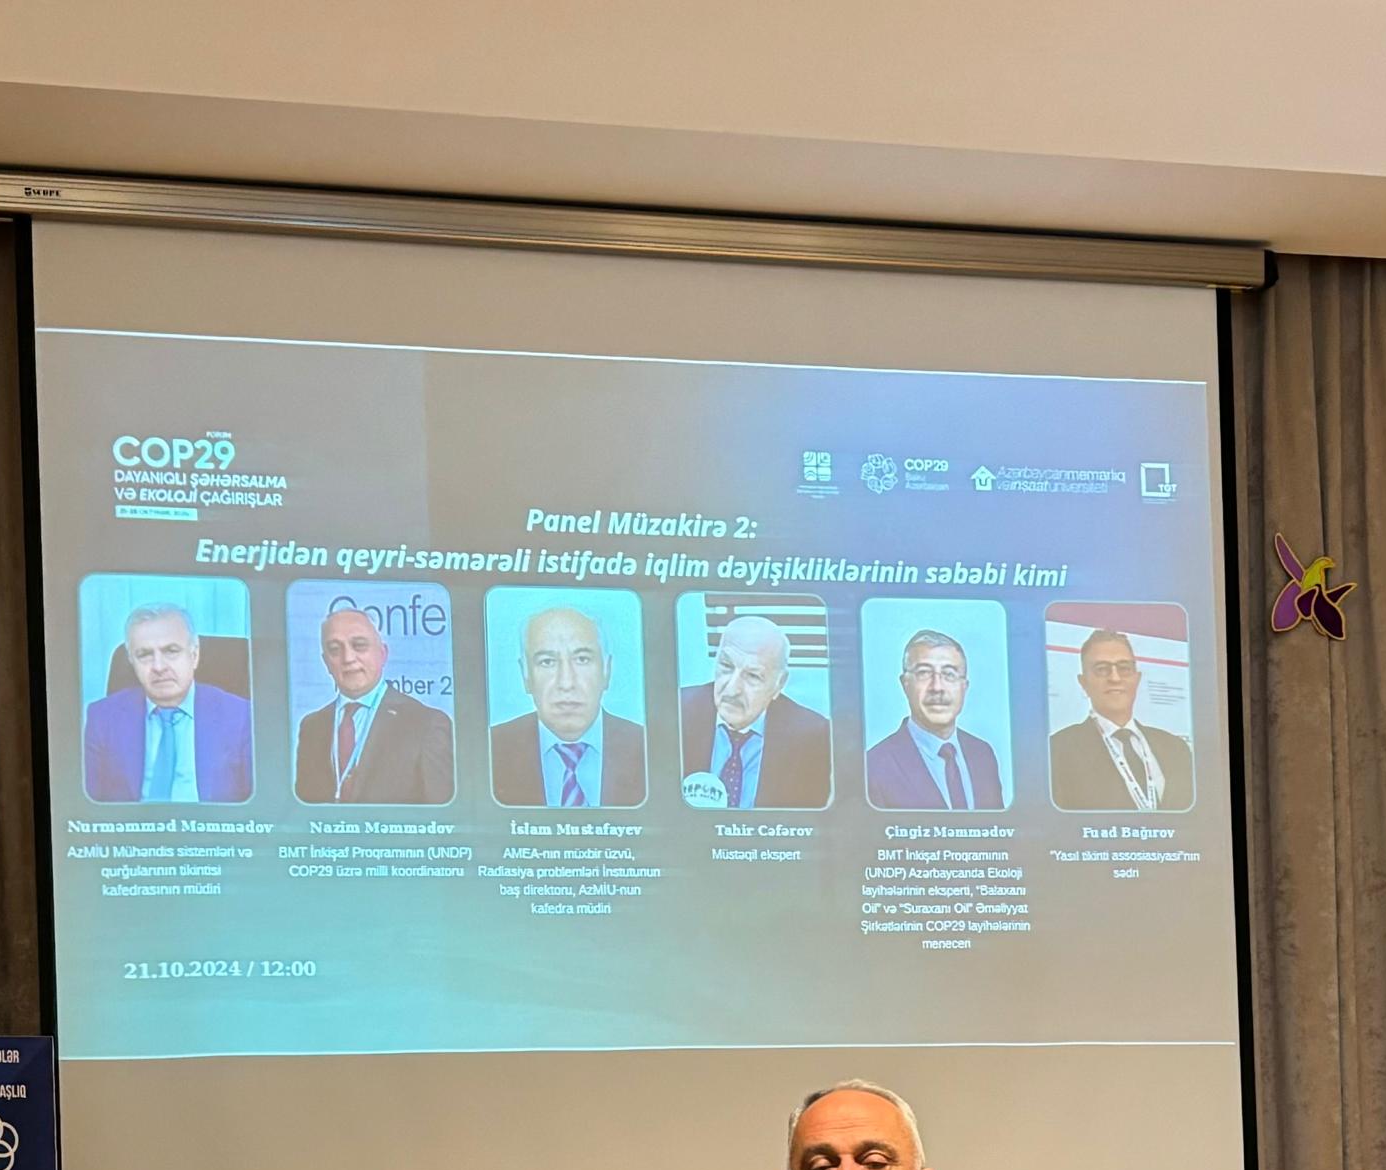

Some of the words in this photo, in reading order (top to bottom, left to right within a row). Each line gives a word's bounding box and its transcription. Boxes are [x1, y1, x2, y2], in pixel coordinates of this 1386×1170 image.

[113, 436, 235, 470] COP29
[115, 470, 186, 485] DAYANIQLI
[190, 473, 287, 489] ŞƏHƏRSALMA
[114, 487, 136, 500] VƏ
[200, 490, 283, 508] ÇAĞIRIŞLAR
[526, 508, 599, 535] Panel
[608, 511, 726, 538] Müzakirə
[734, 516, 757, 539] 2:
[195, 539, 327, 571] Enerjidən
[336, 544, 530, 574] qeyri-səmərəli
[538, 548, 637, 580] istifadə
[645, 553, 709, 583] iqlim
[717, 555, 918, 587] dəyişikliklərinin
[926, 561, 1007, 585] səbəbi
[1012, 563, 1068, 587] kimi
[67, 819, 176, 833] Nurməmməd
[181, 819, 274, 833] Məmmədov
[310, 821, 360, 834] Nazim
[365, 821, 455, 834] Məmmədov
[510, 820, 552, 836] İslam
[556, 822, 643, 838] Mustafayev
[715, 824, 755, 837] Tahir
[758, 824, 814, 837] Cəfərov
[885, 825, 931, 839] Çingiz
[933, 826, 1015, 838] Məmmədov
[1083, 826, 1117, 838] Fuad
[1121, 827, 1175, 840] Bağırov
[113, 845, 174, 858] Mühəndis
[237, 848, 253, 858] və
[279, 846, 307, 858] BMT
[427, 846, 472, 861] (UNDP)
[877, 849, 903, 861] BMT
[289, 865, 333, 877] COP29
[391, 865, 464, 877] koordinatoru
[499, 884, 520, 898] baş
[926, 920, 965, 932] COP29
[124, 960, 243, 979] 21.10.2024
[261, 960, 317, 977] 12:00
